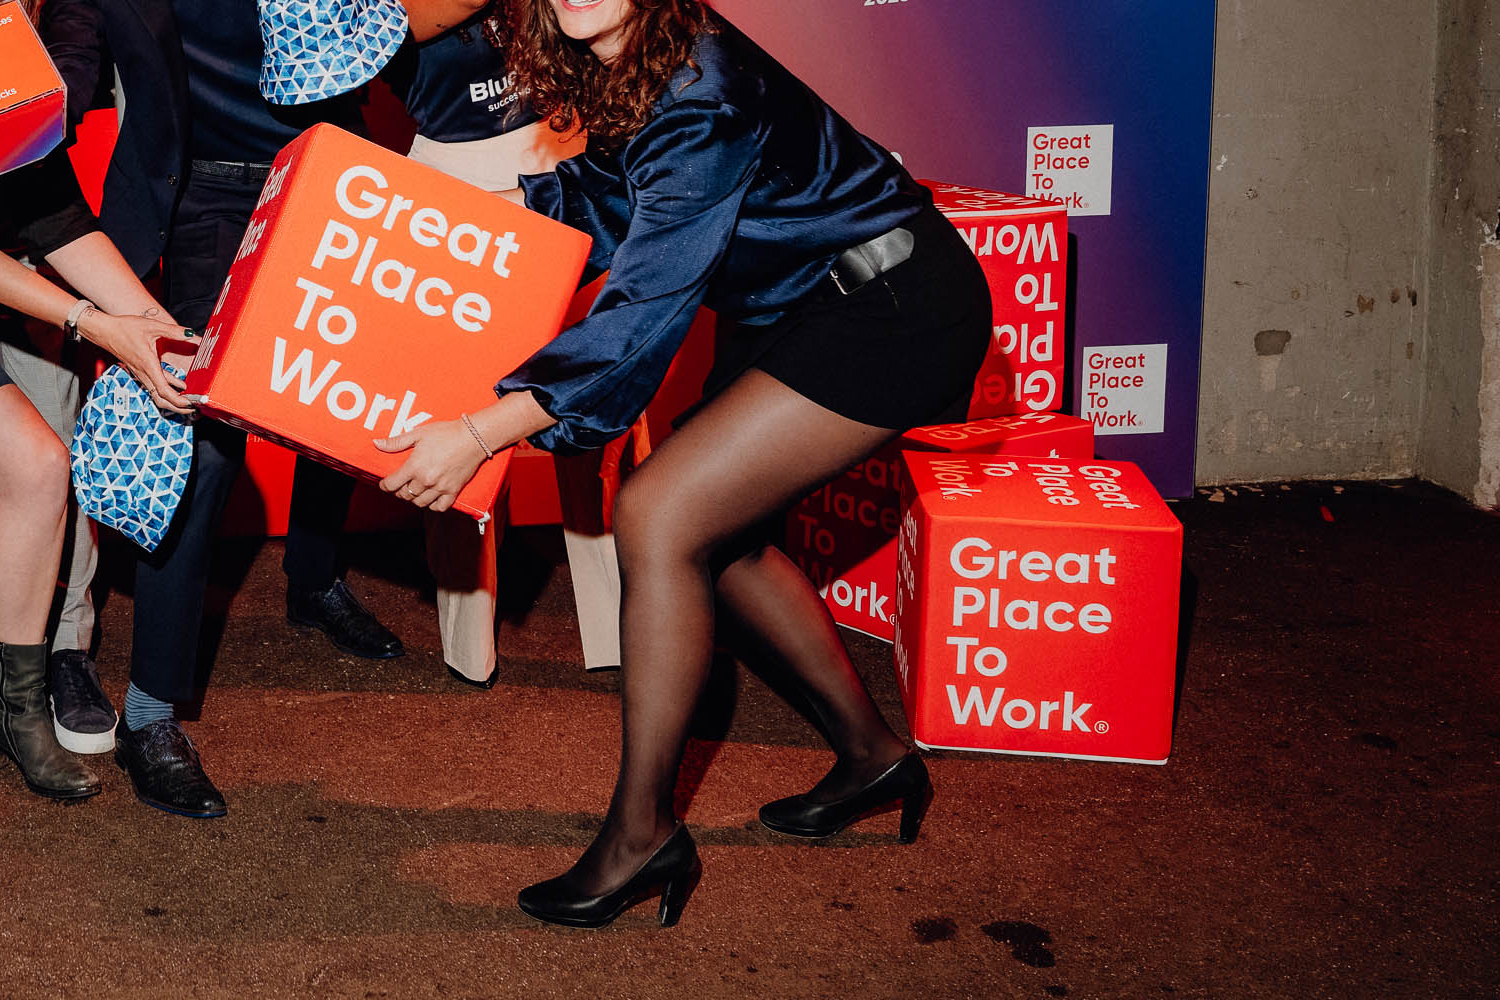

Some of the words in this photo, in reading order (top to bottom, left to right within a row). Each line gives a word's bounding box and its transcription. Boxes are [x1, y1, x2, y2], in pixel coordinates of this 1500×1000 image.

[1033, 134, 1090, 150] Great
[1034, 154, 1089, 170] Place
[1032, 173, 1052, 189] To
[335, 166, 520, 278] Great
[311, 220, 491, 332] Place
[293, 277, 357, 345] To
[1089, 353, 1144, 369] Great
[1089, 373, 1143, 388] Place
[269, 336, 432, 438] Work
[1088, 392, 1108, 408] To
[950, 537, 1116, 585] Great
[952, 588, 1112, 634] Place
[947, 637, 1007, 677] To
